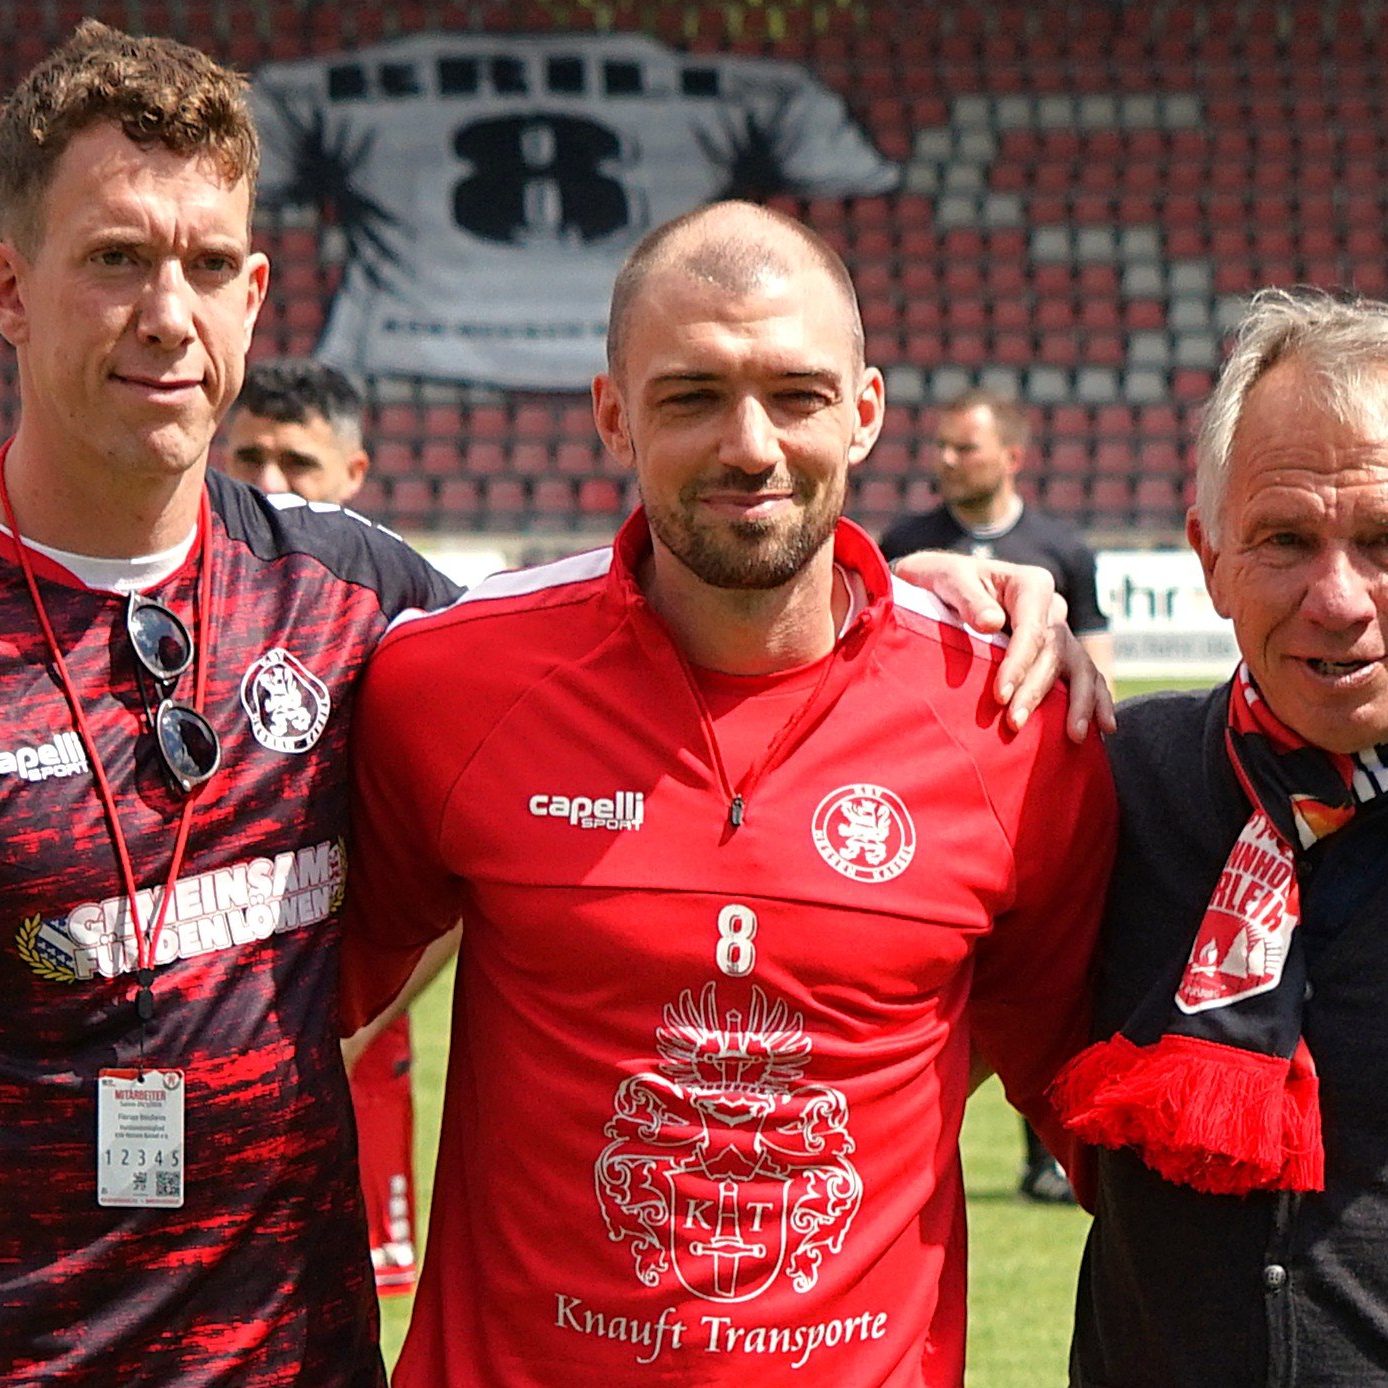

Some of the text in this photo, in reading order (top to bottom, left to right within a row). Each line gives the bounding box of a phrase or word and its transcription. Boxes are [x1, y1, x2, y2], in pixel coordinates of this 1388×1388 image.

[453, 112, 629, 245] 8
[529, 790, 644, 826] capelli
[580, 816, 643, 832] SPORT
[67, 840, 331, 947] GEMEINSAM
[153, 911, 232, 966] DEN
[715, 904, 758, 977] 8
[105, 1149, 179, 1167] 1 2 3 4 5
[682, 1199, 773, 1232] K T
[555, 1293, 888, 1369] Knauft Transporte
